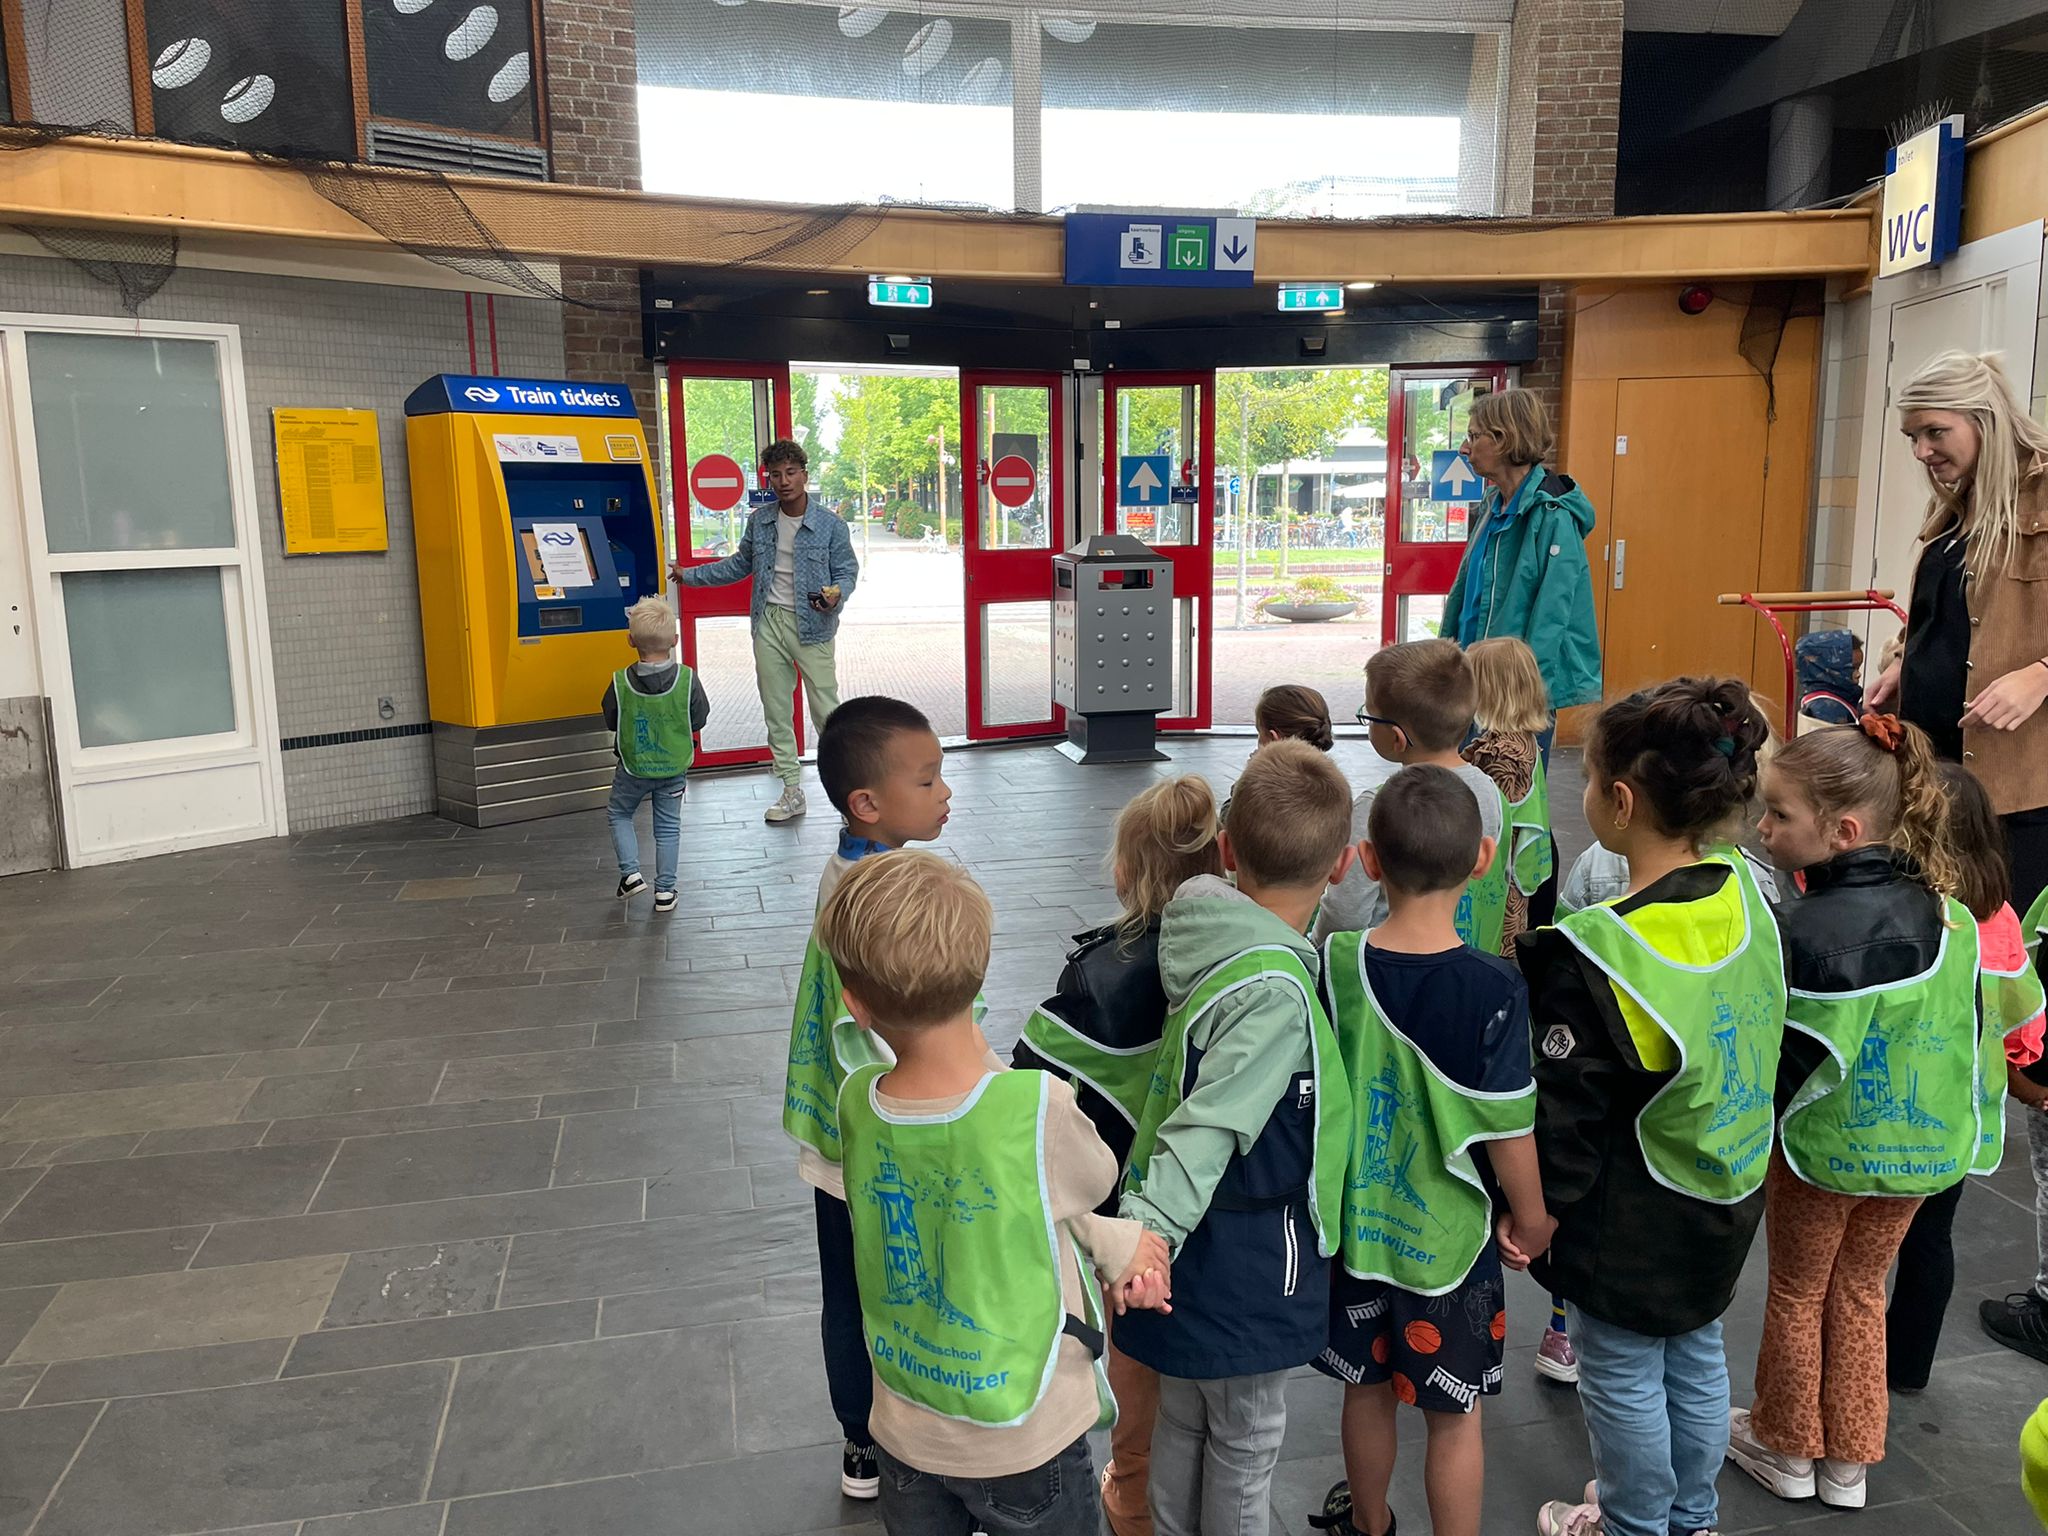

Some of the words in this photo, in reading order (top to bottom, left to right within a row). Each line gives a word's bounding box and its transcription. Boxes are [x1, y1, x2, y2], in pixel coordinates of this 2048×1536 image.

[1898, 151, 1914, 166] toilet
[1888, 203, 1929, 262] WC
[506, 386, 557, 406] Train
[560, 389, 620, 407] tickets
[1696, 1156, 1724, 1175] De
[1829, 1157, 1855, 1173] De
[1862, 1157, 1957, 1177] Windwijzer
[875, 1335, 894, 1362] De
[899, 1346, 1009, 1395] Windwijzer
